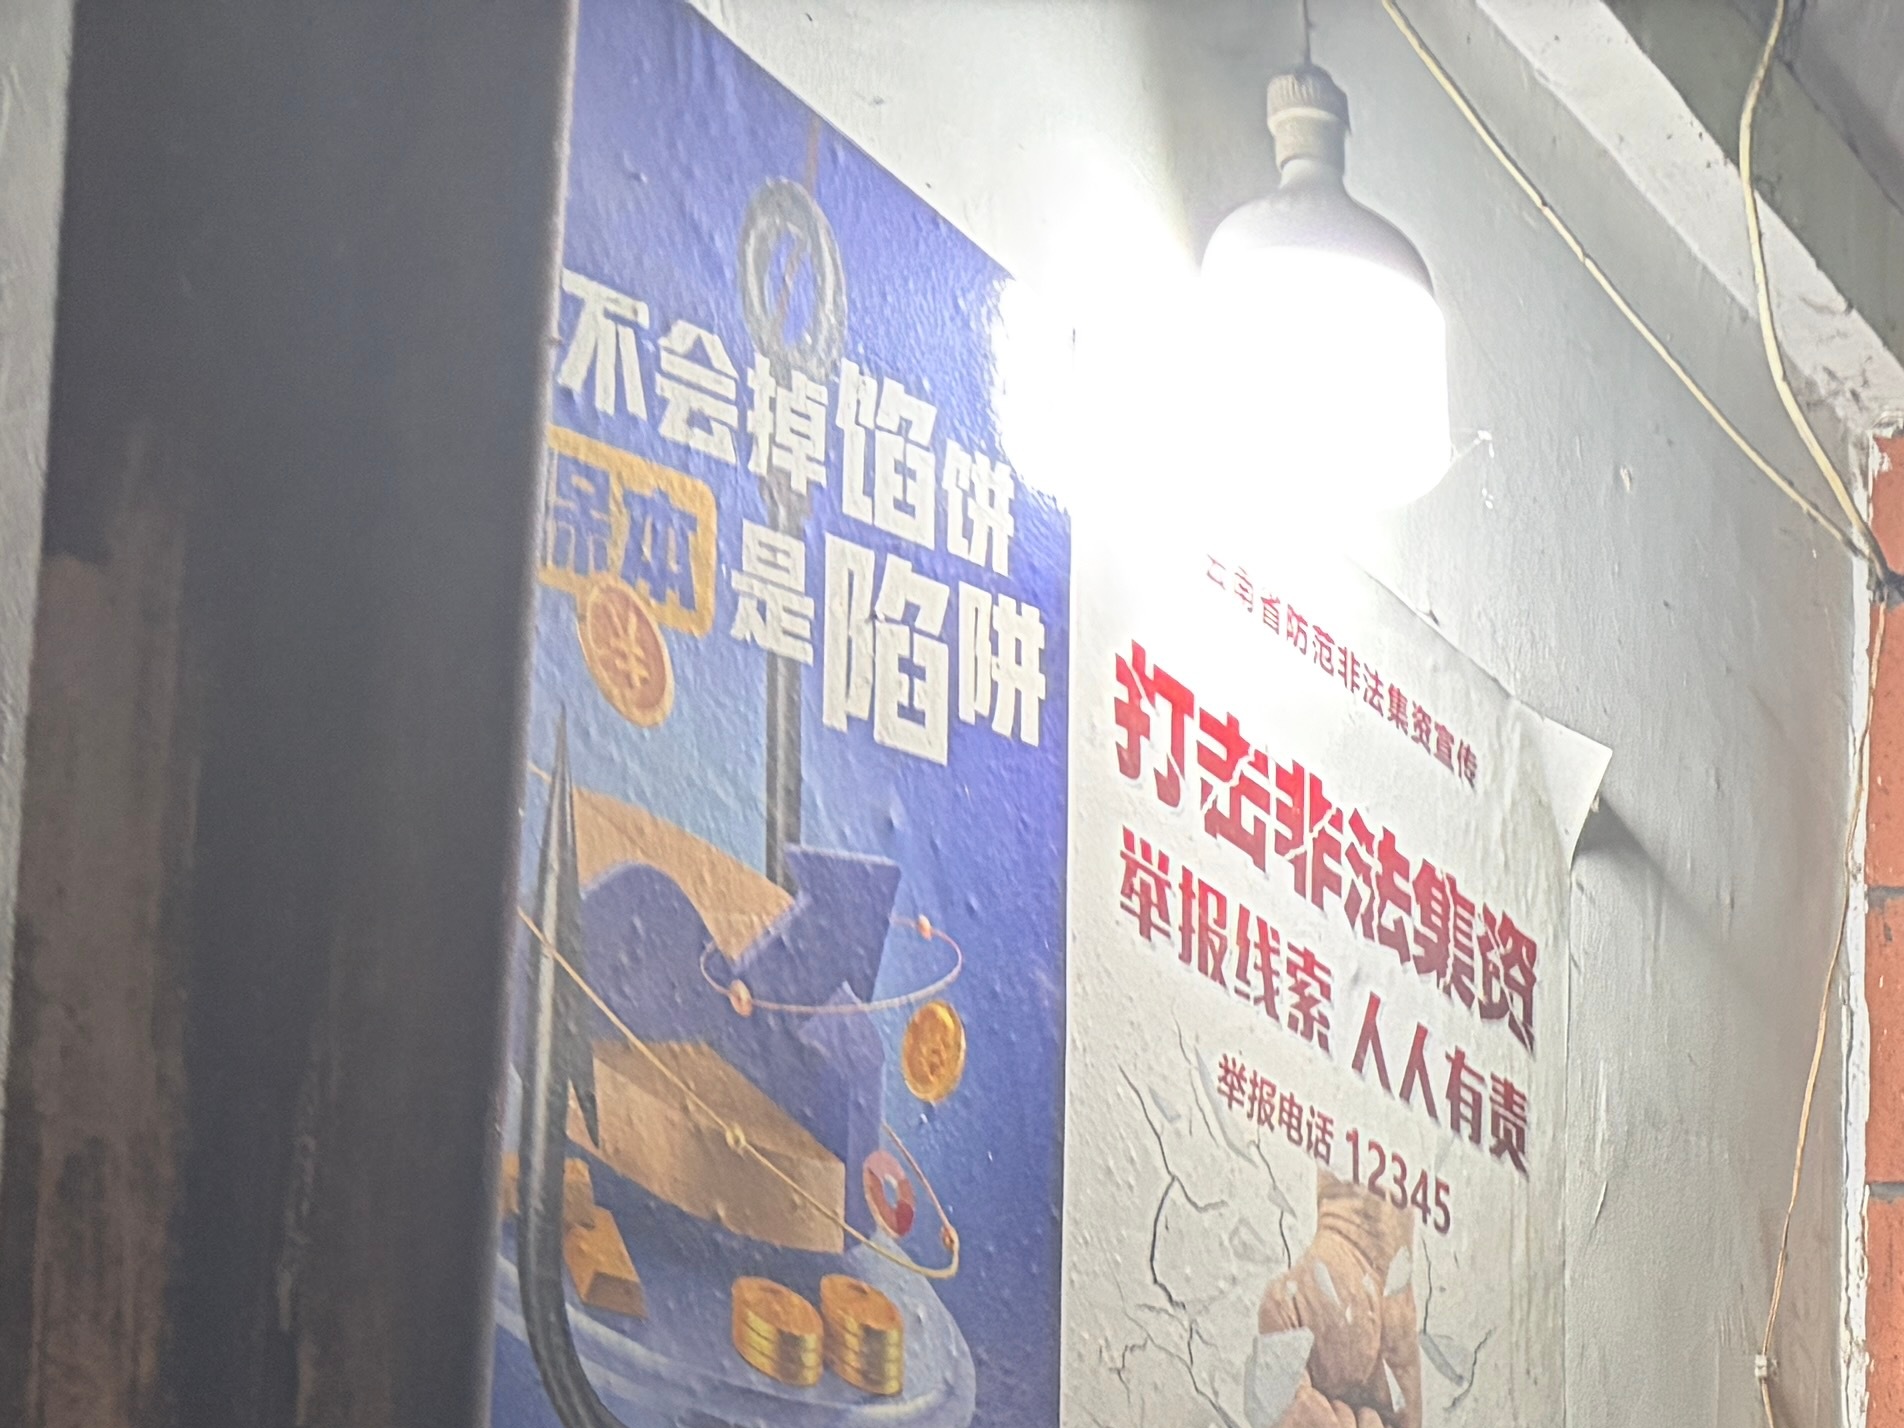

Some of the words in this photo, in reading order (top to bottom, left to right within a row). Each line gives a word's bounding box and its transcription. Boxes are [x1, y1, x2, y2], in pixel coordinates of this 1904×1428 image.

[556, 265, 1016, 577] 不会掉馅饼
[1113, 638, 1538, 1056] 打击非法集资
[1118, 824, 1332, 1054] 举报线索
[1350, 992, 1531, 1183] 人人有责
[1216, 1052, 1335, 1166] 举报电话
[1344, 1128, 1453, 1236] 12345
